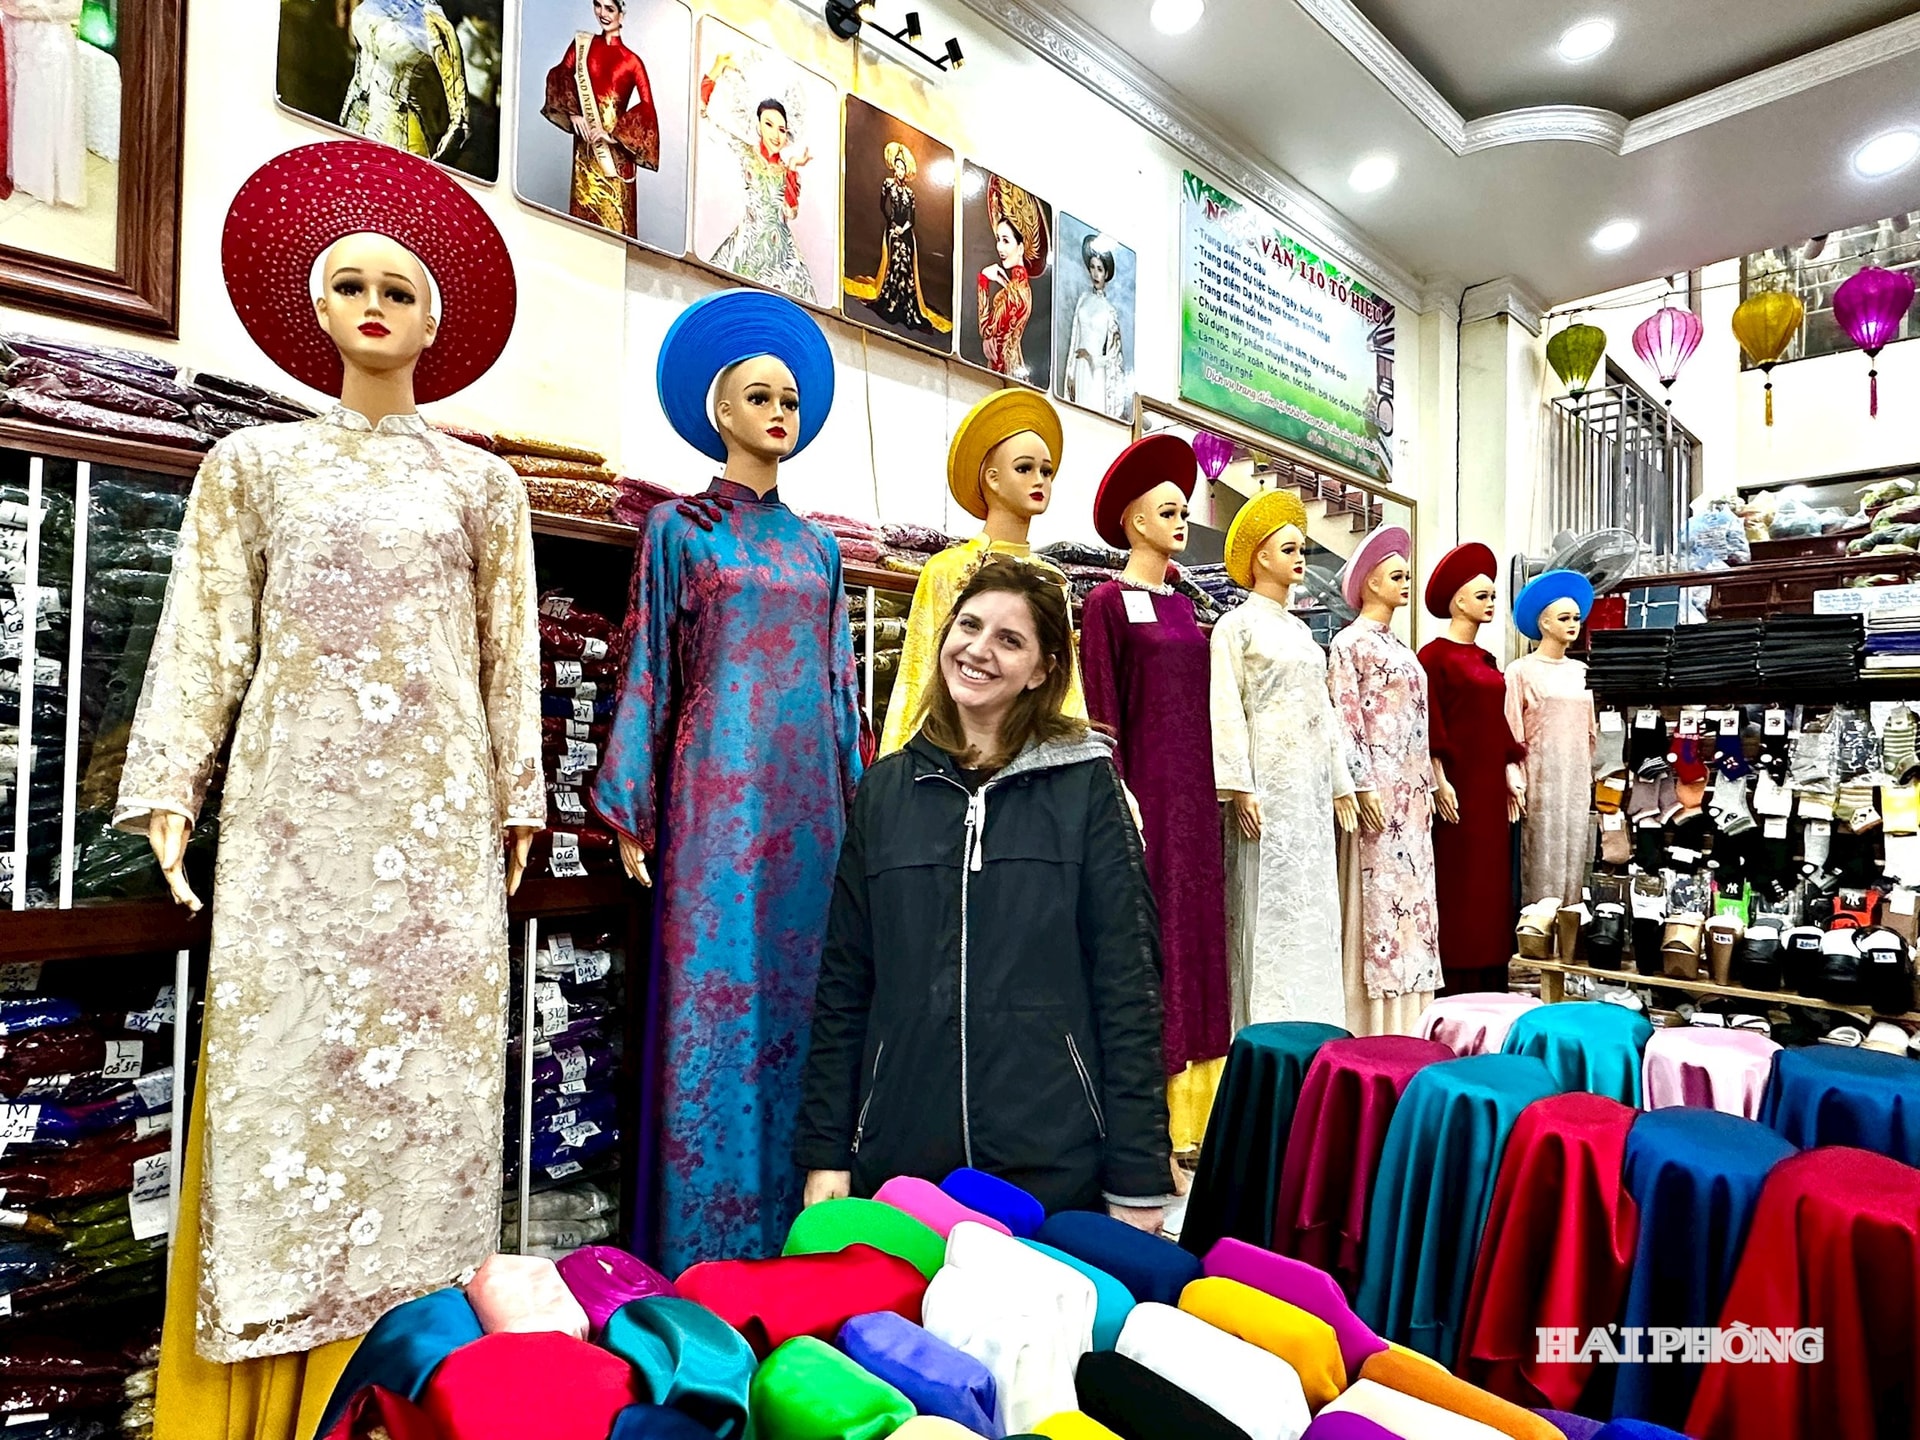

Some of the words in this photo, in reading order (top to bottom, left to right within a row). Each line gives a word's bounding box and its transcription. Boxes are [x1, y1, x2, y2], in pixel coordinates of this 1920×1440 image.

[577, 61, 588, 92] GRAND
[1199, 227, 1222, 252] Trang
[1223, 244, 1242, 261] điểm
[1199, 244, 1222, 268] Trang
[1223, 259, 1241, 277] điểm
[1253, 277, 1266, 292] tiệc
[1267, 285, 1281, 299] ban
[1199, 261, 1222, 285] Trang
[1222, 276, 1241, 293] điểm
[1242, 286, 1253, 300] Dạ
[1262, 234, 1294, 270] VÂN
[1299, 261, 1325, 290] 110
[1329, 275, 1347, 304] TÔ
[1349, 290, 1382, 326] HIỆU
[1198, 278, 1222, 302] Trang
[1222, 292, 1241, 310] điểm
[1242, 303, 1256, 318] tuổi
[1257, 311, 1272, 326] teen
[1198, 295, 1228, 319] Chuyên
[1229, 314, 1245, 327] viên
[1245, 321, 1265, 340] trang
[1309, 354, 1320, 368] tay
[1336, 370, 1347, 381] cao
[1210, 320, 1229, 339] dụng
[1264, 348, 1289, 366] chuyên
[1290, 360, 1312, 378] nghiệp
[559, 660, 580, 677] XL
[558, 793, 581, 808] XL
[116, 1041, 135, 1058] L
[563, 1083, 579, 1092] XL
[6, 1104, 30, 1120] M
[146, 1157, 167, 1171] XL
[561, 1232, 575, 1246] M
